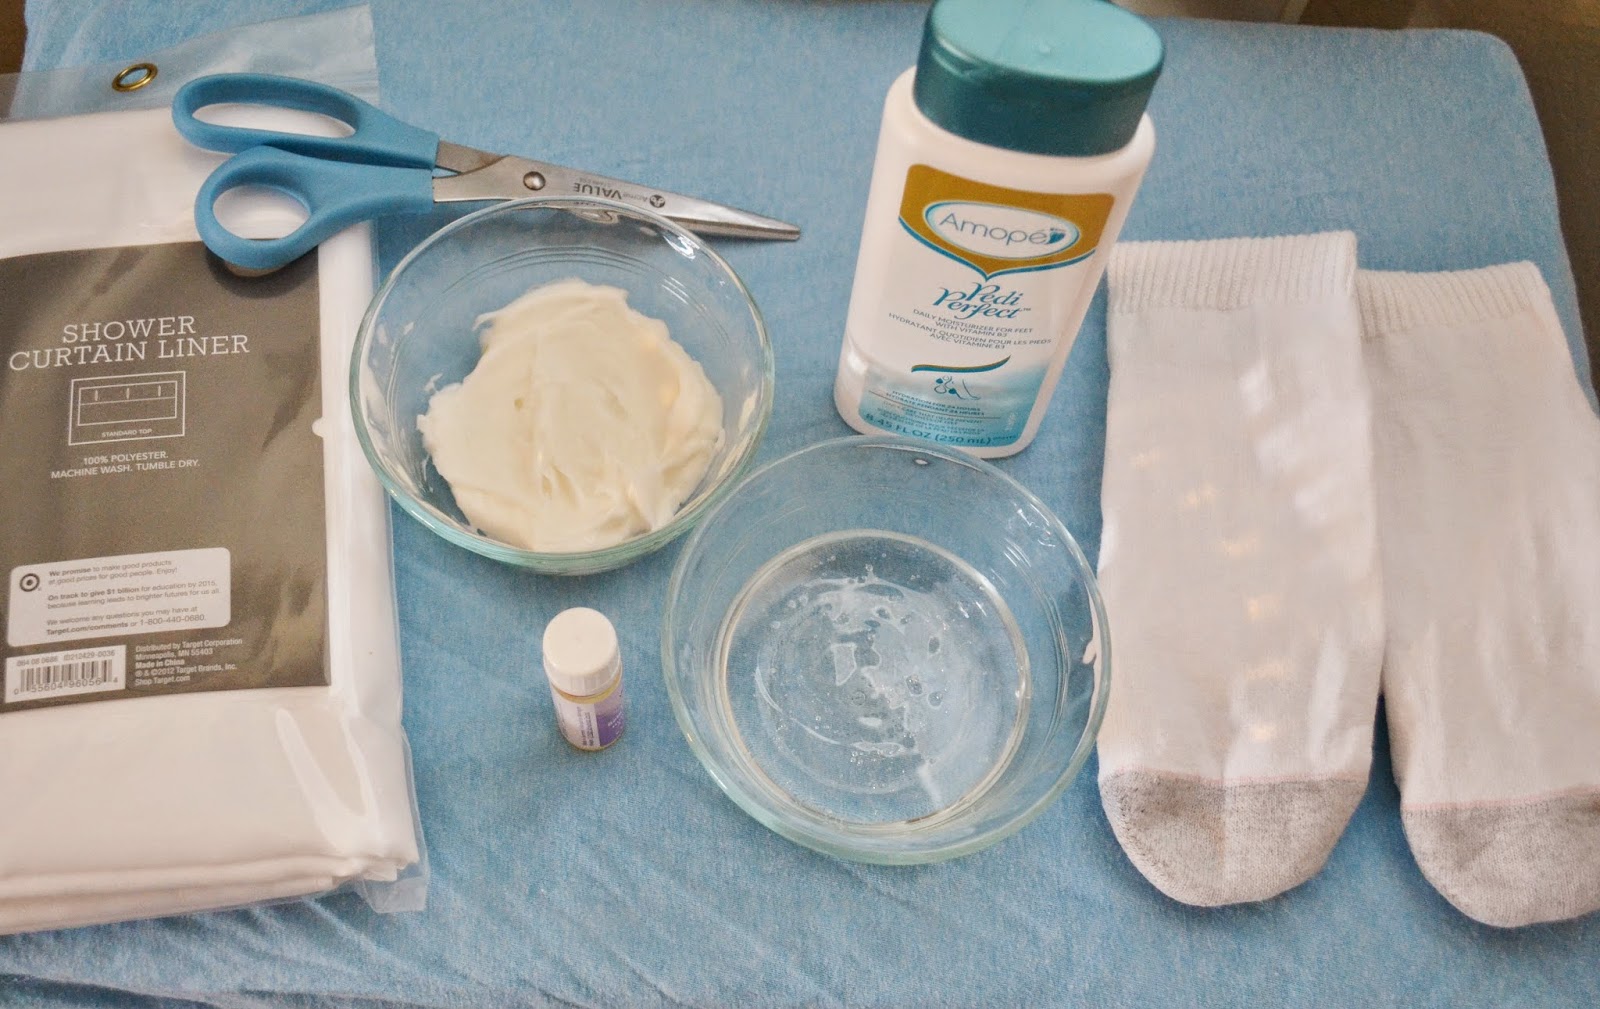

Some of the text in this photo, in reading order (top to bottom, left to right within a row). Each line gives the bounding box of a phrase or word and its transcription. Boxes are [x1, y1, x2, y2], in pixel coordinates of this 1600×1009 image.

[573, 182, 622, 200] VALUE
[939, 212, 1048, 246] Amopé
[965, 282, 1024, 305] Pedi
[932, 287, 1022, 320] Perfect
[913, 308, 936, 321] DAILY
[938, 317, 994, 331] MOISTURIZER
[62, 315, 197, 344] SHOWER
[888, 312, 937, 333] HYDRATANT
[939, 330, 987, 343] QUOTIDIEN
[935, 321, 958, 331] WITH
[960, 326, 996, 336] VITAMIN
[930, 333, 951, 343] AVEC
[953, 338, 993, 350] VITAMINE
[9, 335, 250, 371] CURTAIN LINER
[101, 429, 137, 438] STANDARD
[896, 424, 911, 434] FL
[912, 430, 932, 439] OZ
[934, 433, 964, 444] (250
[83, 451, 169, 466] 100% POLYESTER.
[51, 459, 200, 479] MACHINE WASH. TUMBLE DRY.
[62, 567, 91, 576] promise
[141, 560, 172, 568] products
[57, 577, 75, 585] good
[106, 612, 140, 620] questions
[46, 622, 129, 635] Target.com/comments
[135, 643, 171, 652] Distributed
[182, 641, 203, 649] Target
[204, 638, 243, 647] Corporation
[191, 648, 213, 656] 55403
[135, 661, 155, 669] Made
[176, 665, 197, 674] Target
[31, 682, 63, 692] 55604
[69, 677, 102, 688] 96056
[135, 675, 191, 686] Shop Target.com
